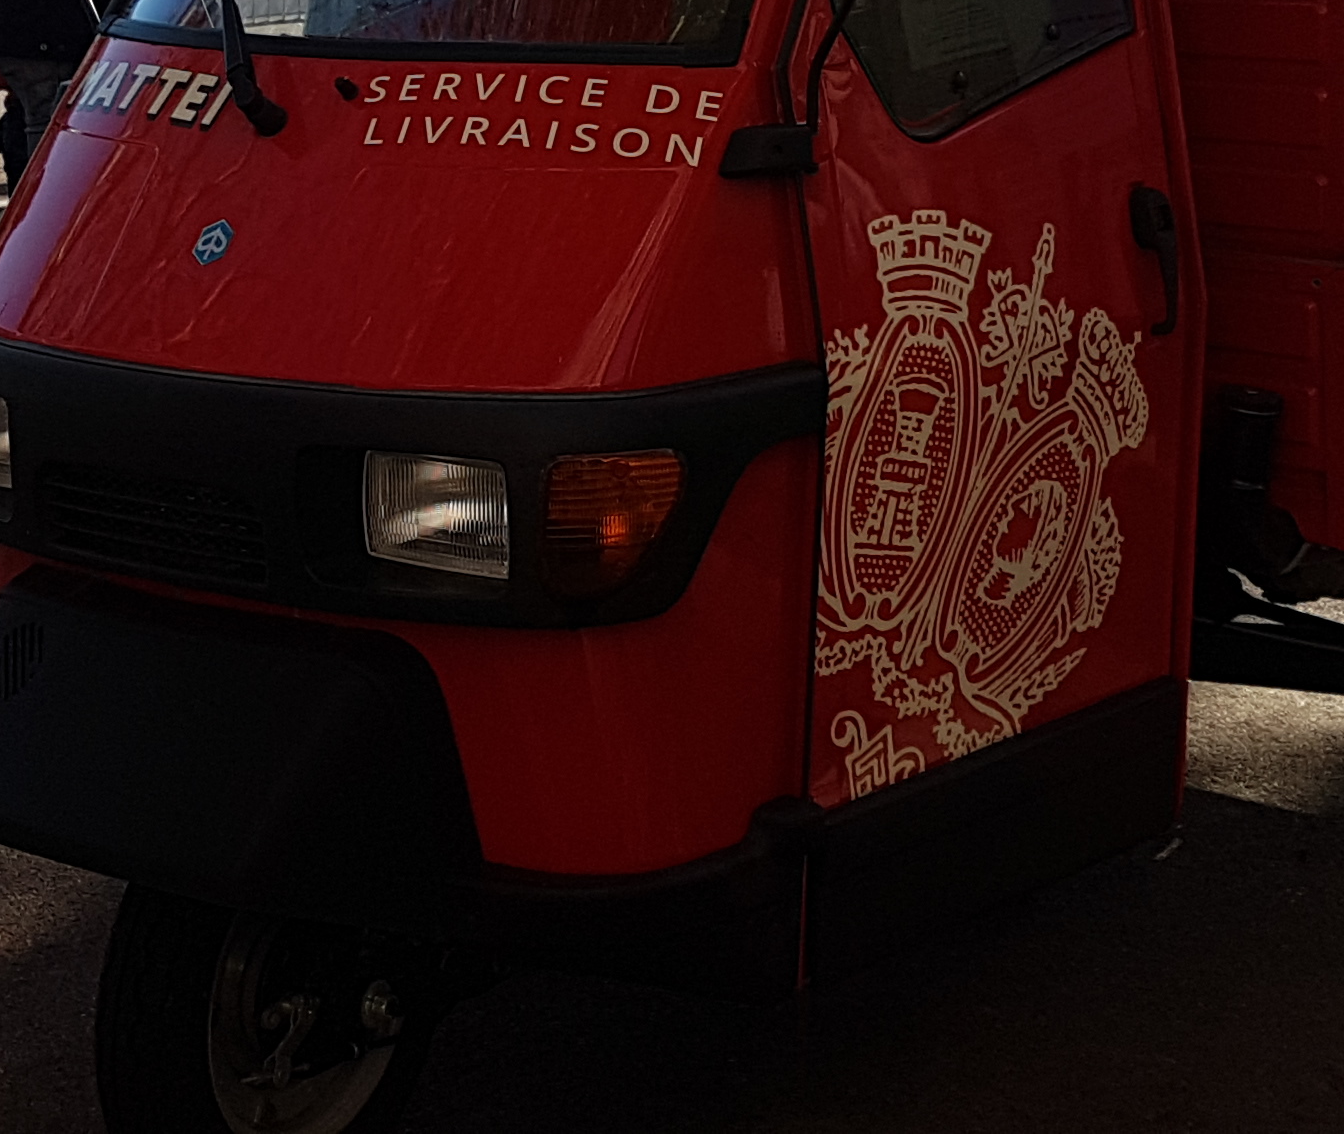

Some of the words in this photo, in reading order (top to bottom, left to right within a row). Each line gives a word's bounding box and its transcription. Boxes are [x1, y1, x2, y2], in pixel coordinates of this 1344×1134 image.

[67, 60, 233, 129] MATTEI
[363, 72, 609, 108] SERVICE
[645, 83, 724, 122] DE
[363, 116, 705, 168] LIVRAISON
